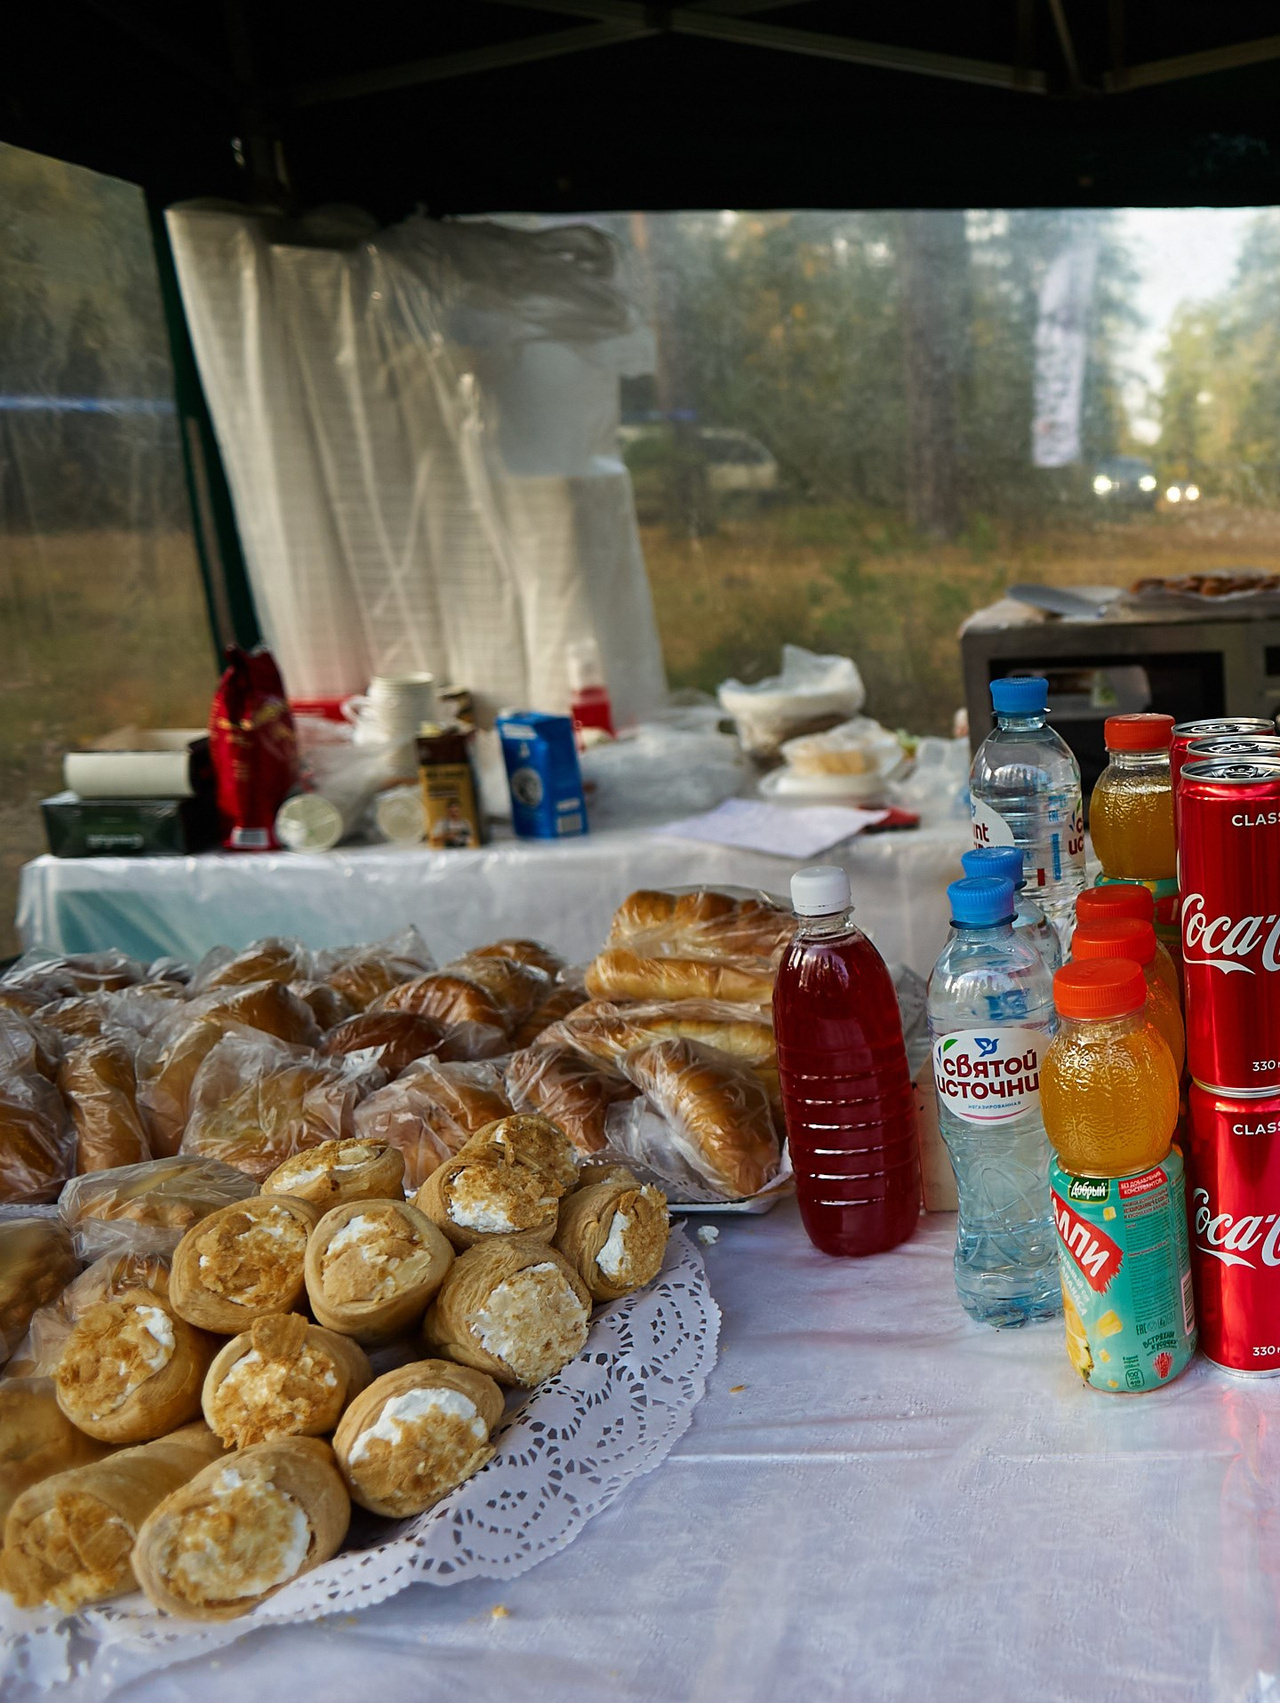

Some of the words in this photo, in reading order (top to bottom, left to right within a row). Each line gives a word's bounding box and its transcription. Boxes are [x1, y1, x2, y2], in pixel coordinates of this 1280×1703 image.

[943, 1049, 1038, 1078] СВЯТОЙ
[1252, 1060, 1276, 1072] 330
[936, 1071, 1041, 1100] ИСТОЧНИ
[1071, 1181, 1107, 1201] Добрый
[1252, 1345, 1276, 1357] 330
